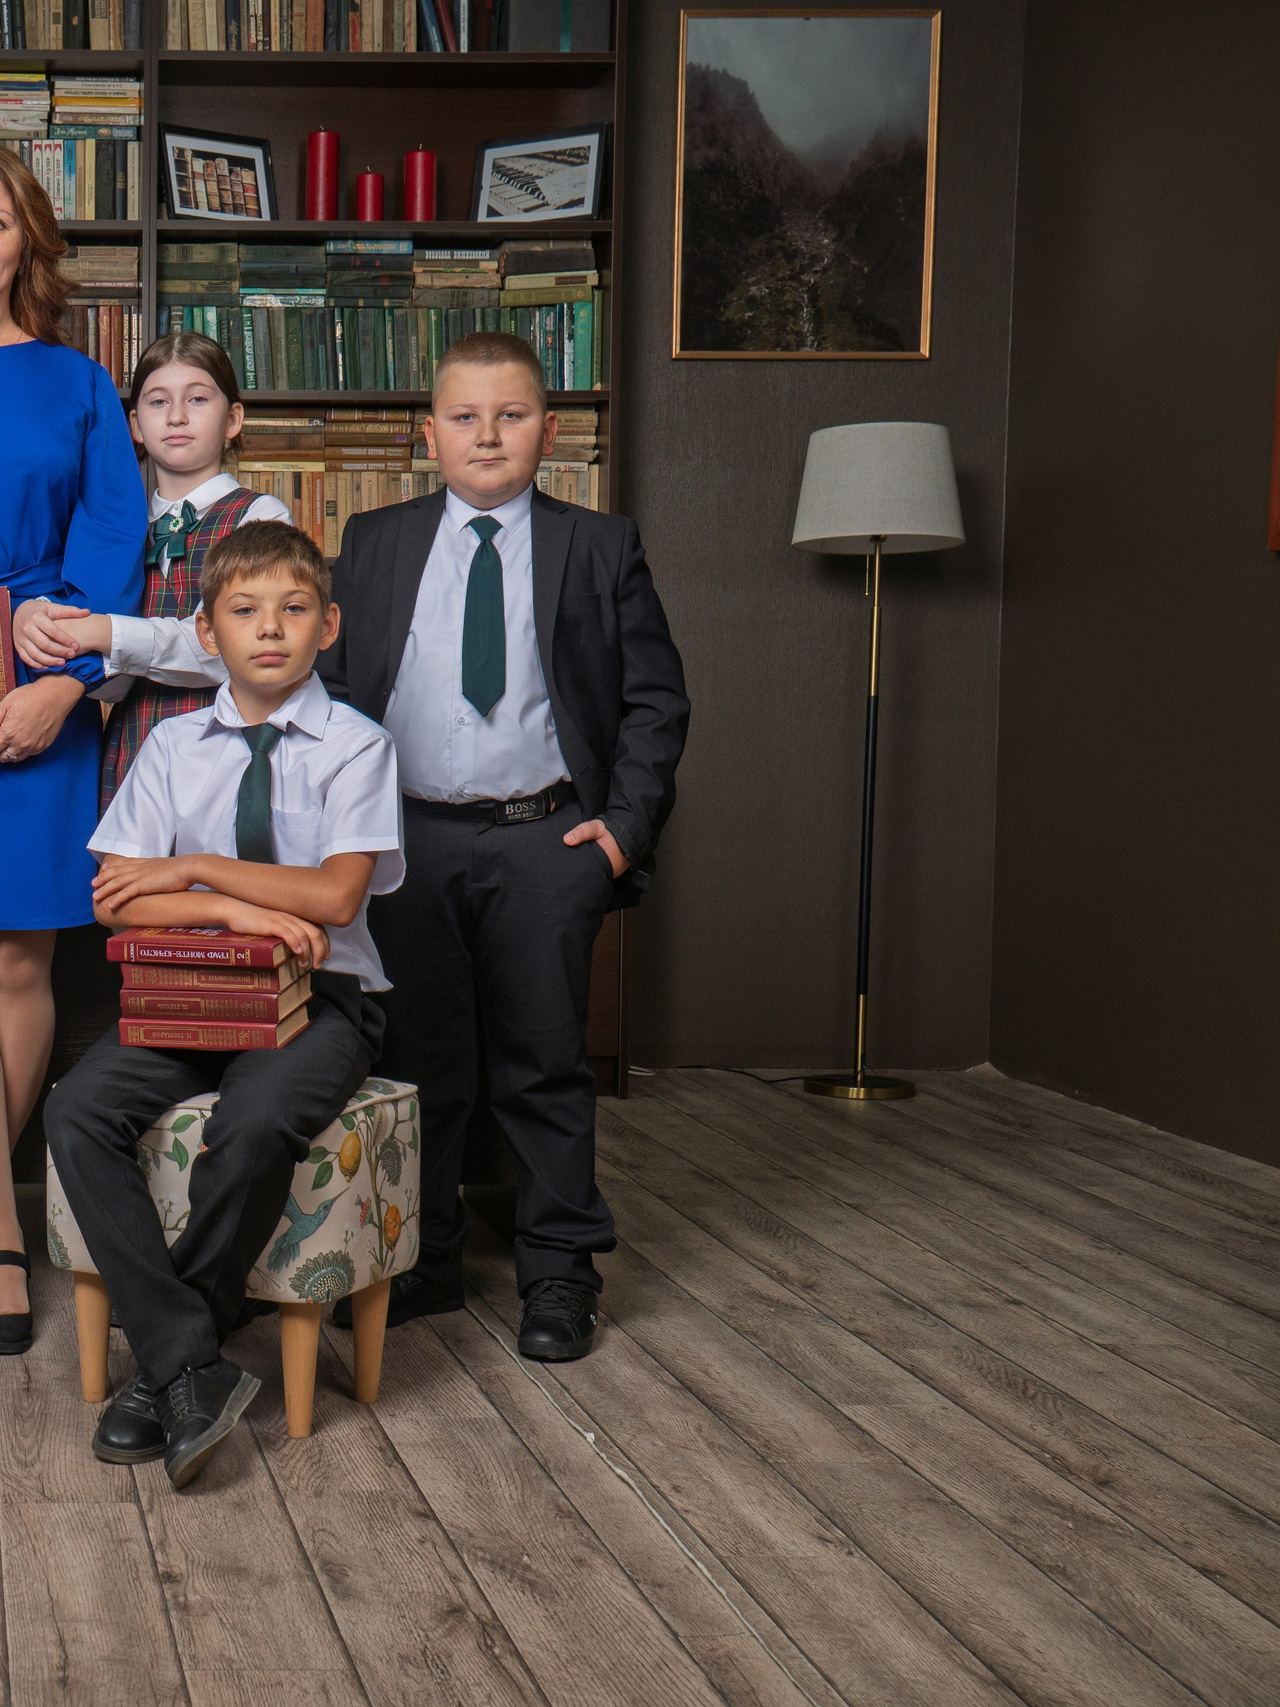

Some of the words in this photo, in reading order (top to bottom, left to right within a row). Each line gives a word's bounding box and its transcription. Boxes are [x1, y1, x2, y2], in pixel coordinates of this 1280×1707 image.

[505, 800, 536, 815] BOSS
[139, 948, 206, 959] МОНТЕ-КРИСТО
[207, 950, 230, 960] ГРАФ
[207, 974, 251, 983] МАЯКОВСКИЙ
[151, 1031, 186, 1039] ГОНЧАРОВ
